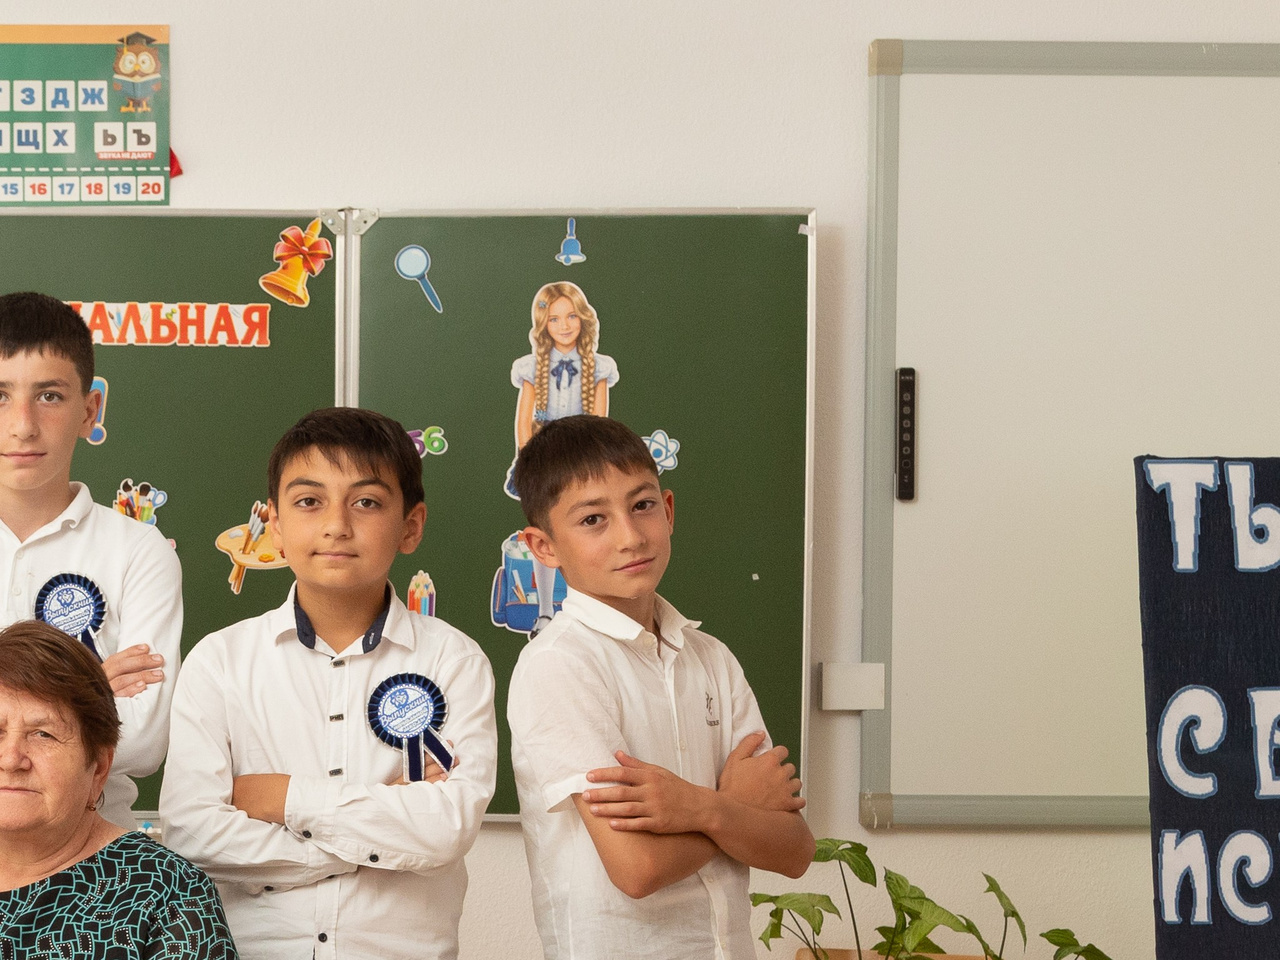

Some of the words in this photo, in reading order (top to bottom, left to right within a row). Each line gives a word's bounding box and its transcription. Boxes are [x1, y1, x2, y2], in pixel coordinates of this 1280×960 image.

[20, 87, 35, 105] З
[51, 87, 70, 108] Д
[81, 88, 105, 105] Ж
[17, 129, 40, 150] Щ
[53, 129, 68, 147] Х
[102, 129, 117, 146] Ь
[132, 129, 151, 146] Ъ
[1, 183, 18, 195] 15
[29, 183, 47, 195] 16
[58, 183, 75, 195] 17
[85, 182, 103, 195] 18
[113, 182, 131, 195] 19
[141, 182, 160, 195] 20
[69, 300, 270, 347] АЛЬНАЯ
[45, 596, 94, 621] Выпускник
[380, 694, 431, 727] Выпускник
